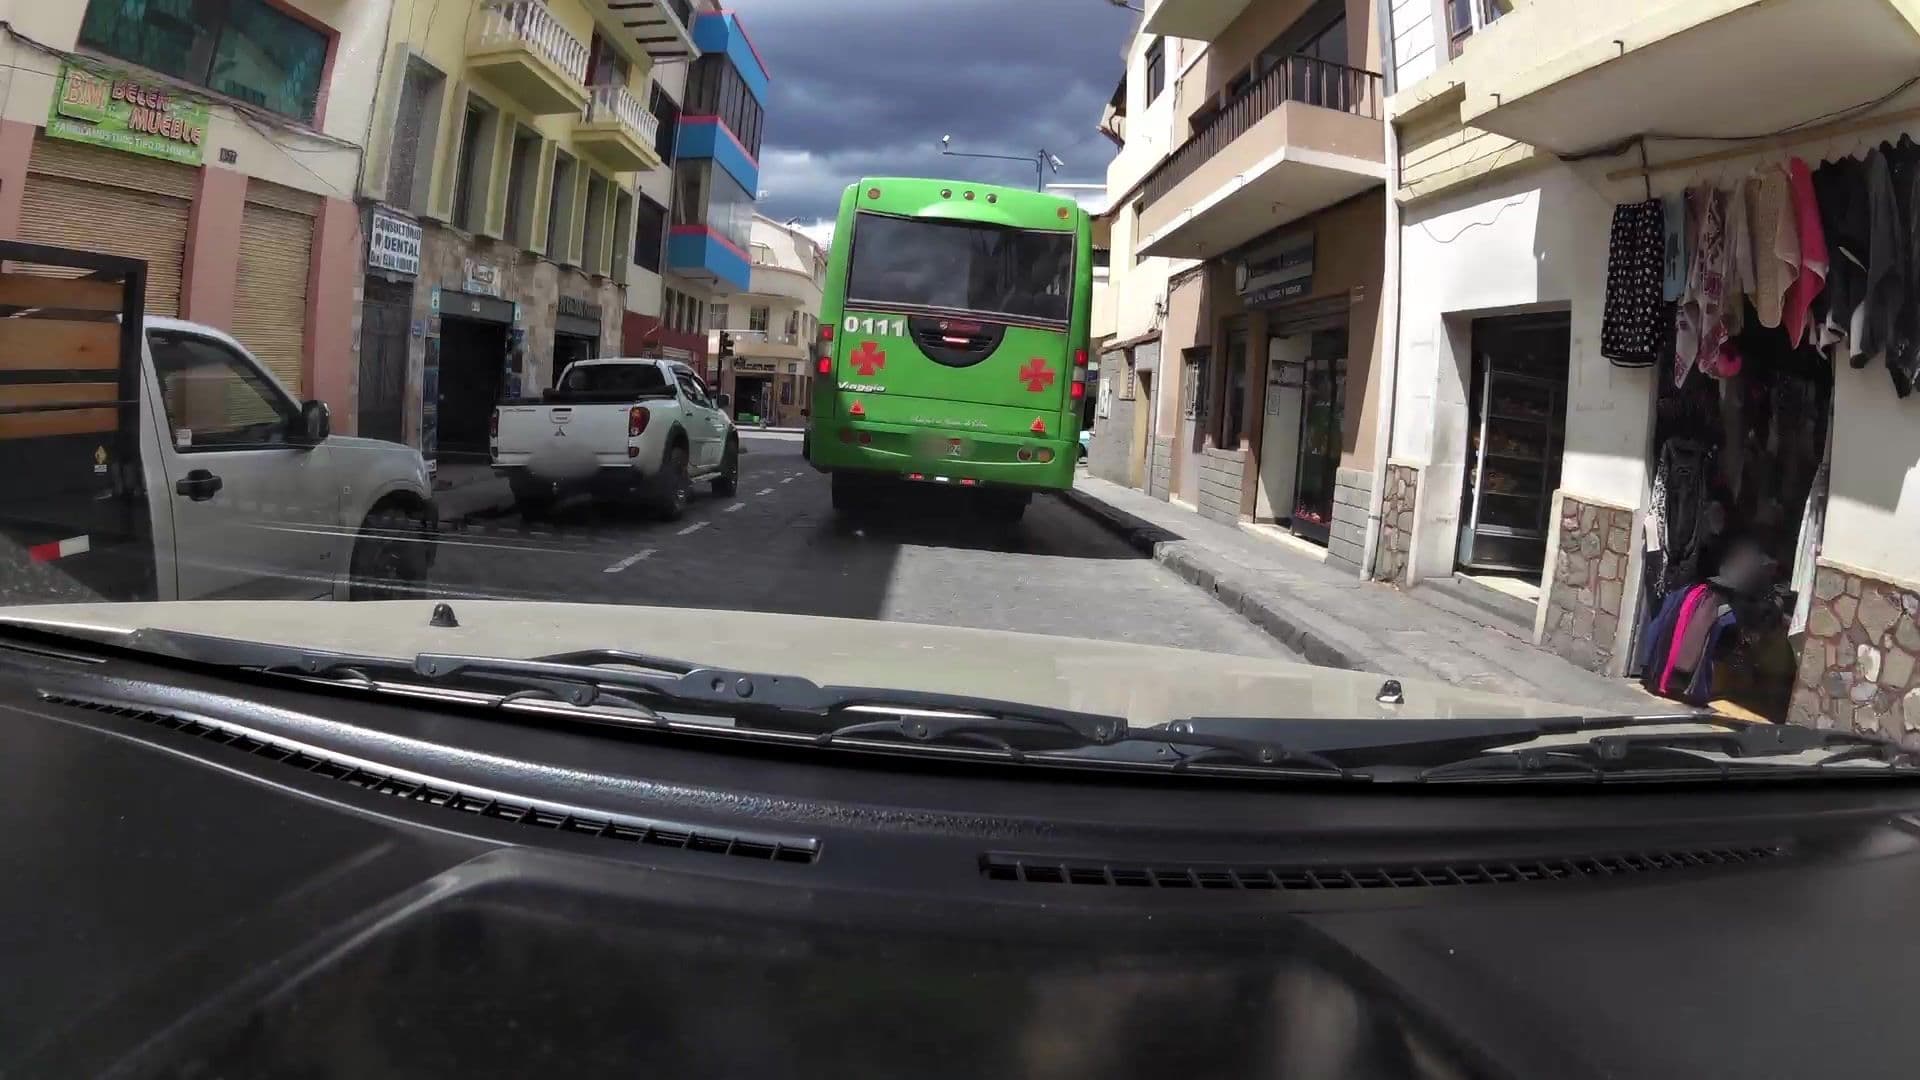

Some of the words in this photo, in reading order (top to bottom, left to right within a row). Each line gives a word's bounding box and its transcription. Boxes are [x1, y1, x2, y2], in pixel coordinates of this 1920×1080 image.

[64, 72, 106, 110] BM
[129, 106, 200, 145] MUEBLE
[384, 235, 418, 257] DENTAL
[844, 316, 904, 337] 0111
[838, 381, 886, 392] Viaggio
